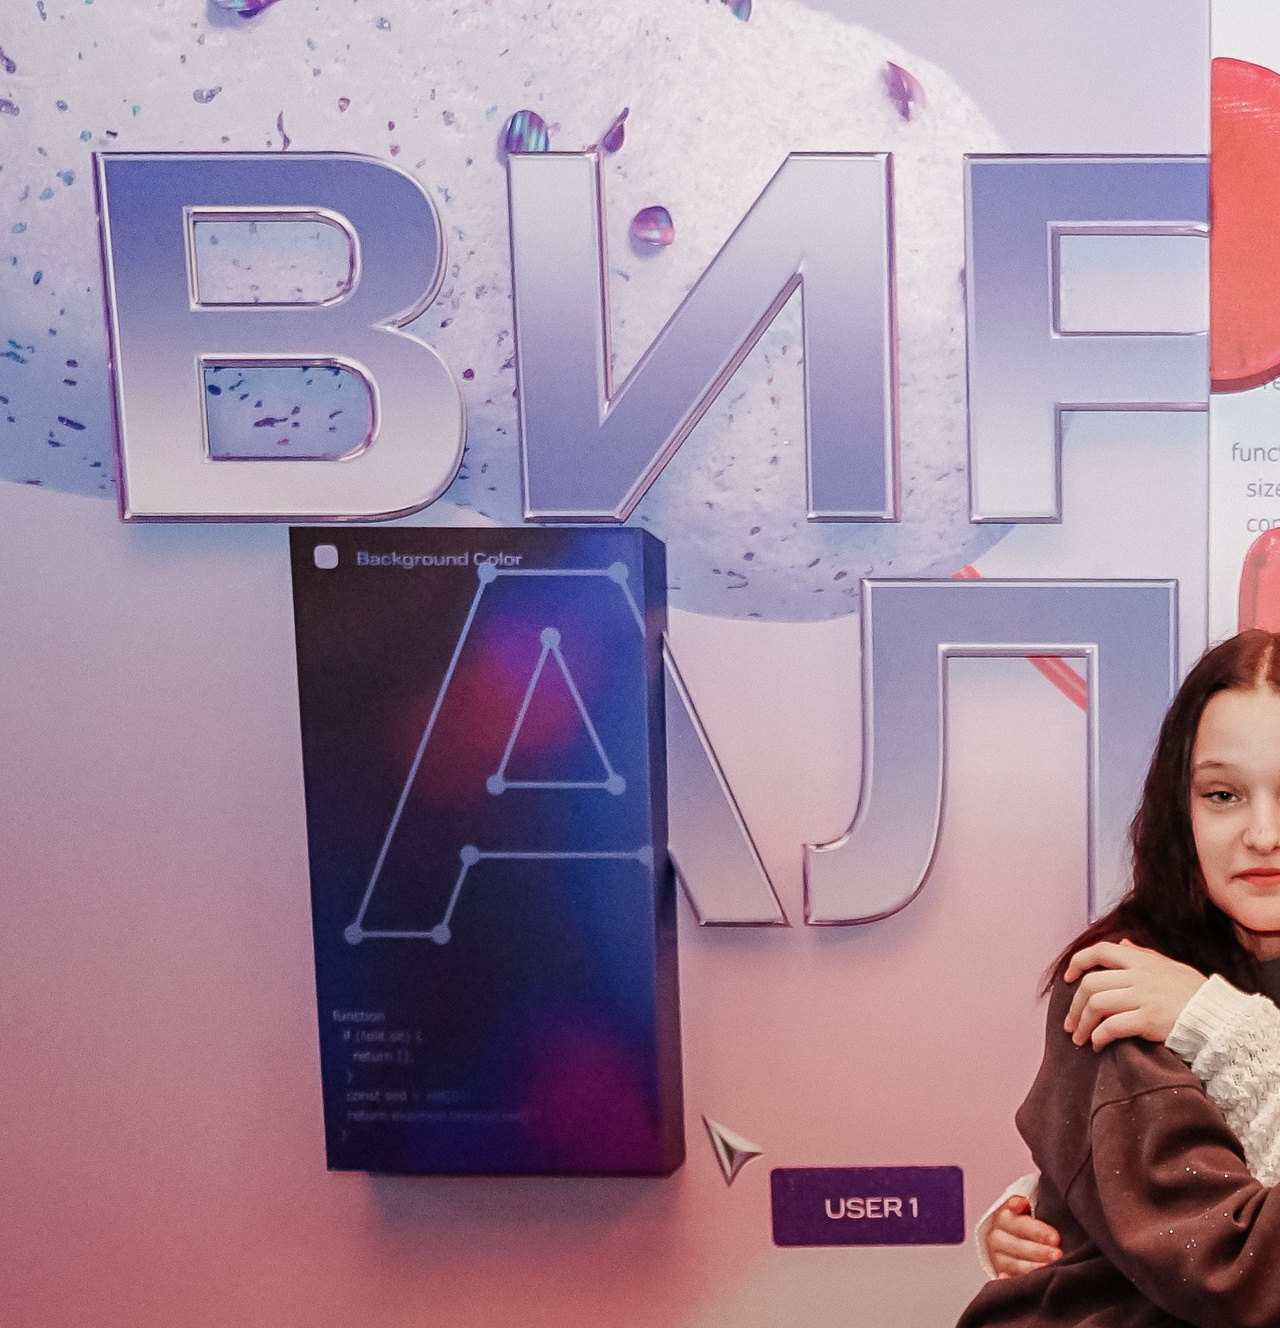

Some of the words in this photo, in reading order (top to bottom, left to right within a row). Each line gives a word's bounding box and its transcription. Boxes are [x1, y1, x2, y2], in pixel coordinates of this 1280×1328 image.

[356, 552, 469, 569] Background
[473, 552, 523, 566] Color
[825, 1197, 903, 1219] USER
[909, 1197, 919, 1218] 1
